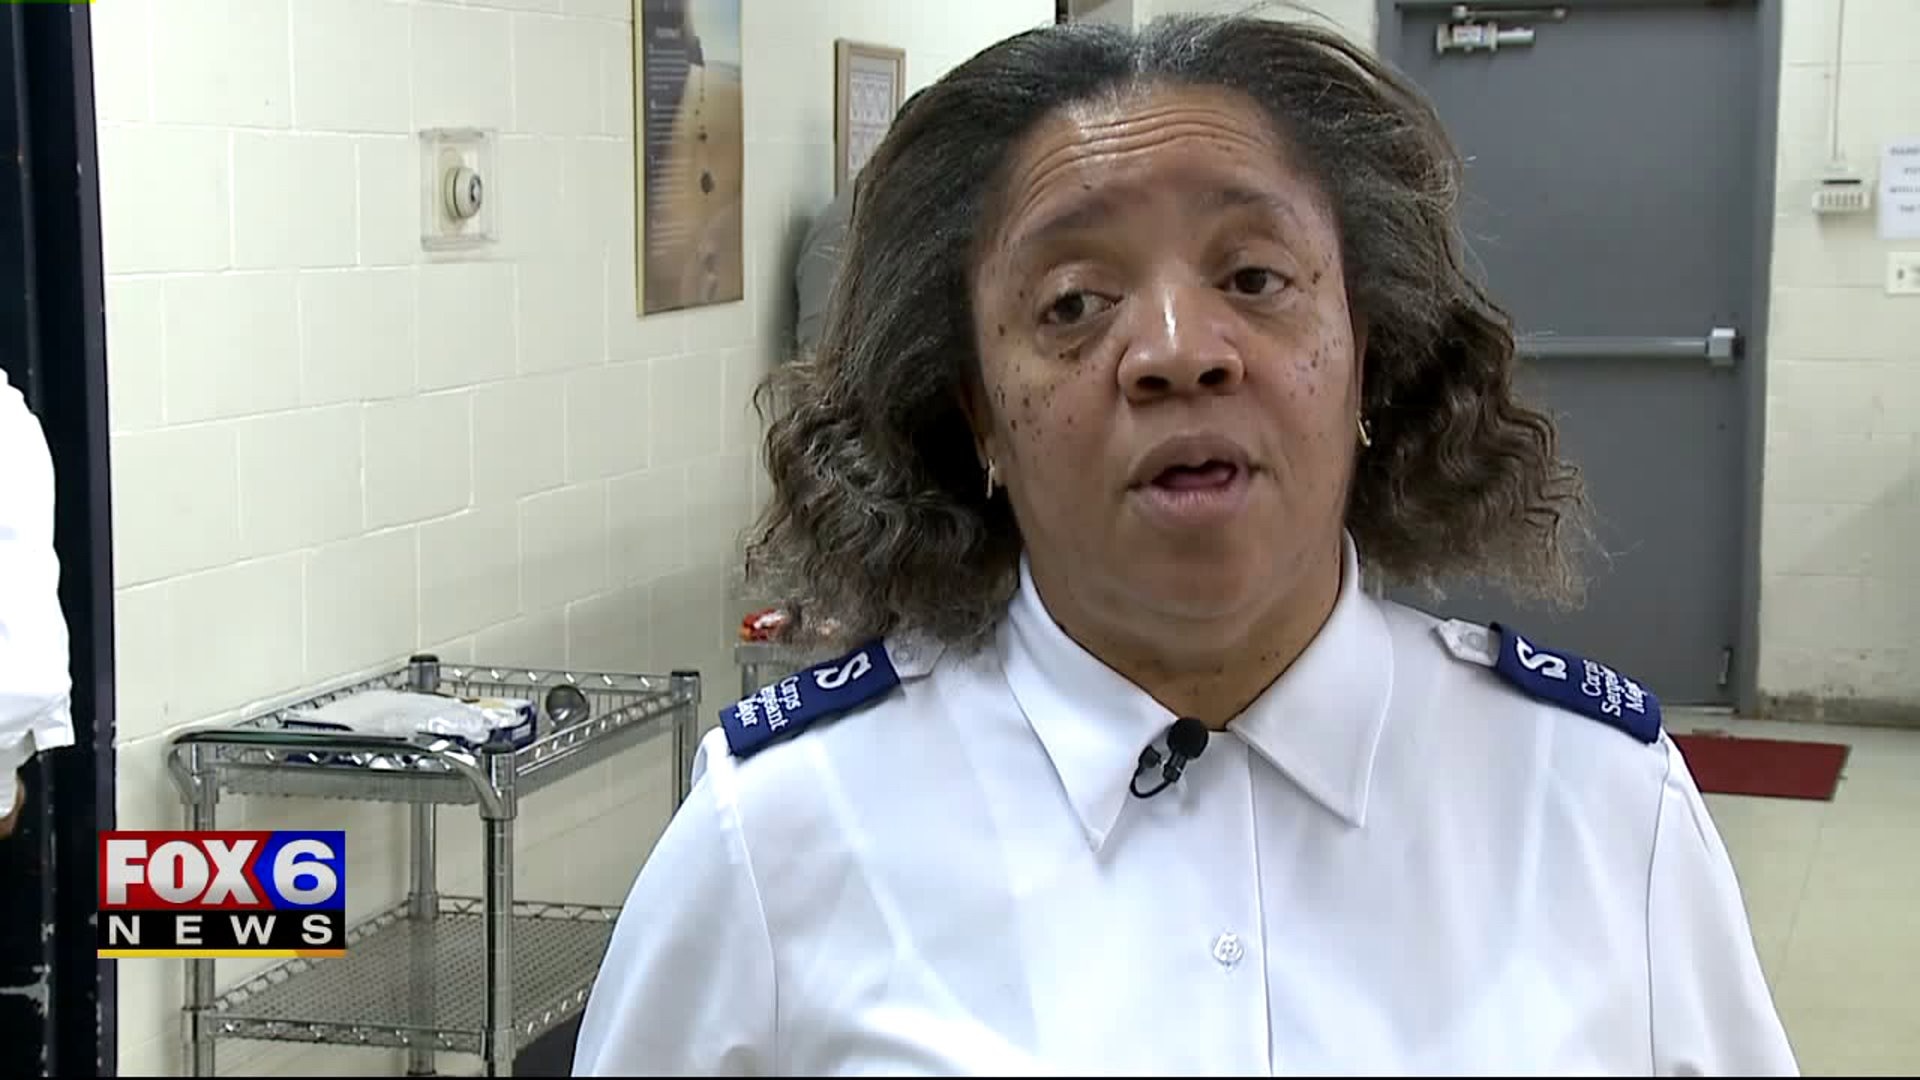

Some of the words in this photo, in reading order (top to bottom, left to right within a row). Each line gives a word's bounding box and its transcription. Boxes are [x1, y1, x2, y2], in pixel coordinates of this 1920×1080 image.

[813, 651, 873, 690] S
[1515, 636, 1568, 681] S
[760, 685, 790, 732] ergeant
